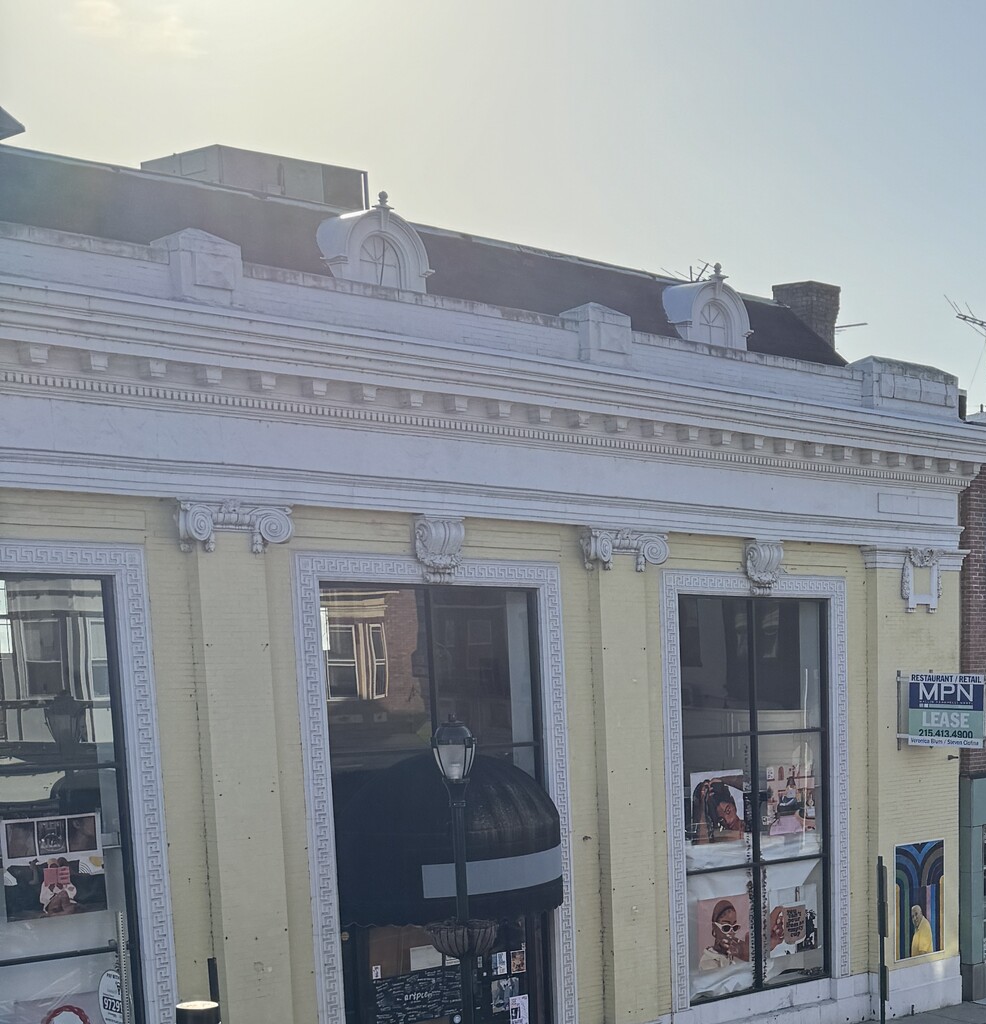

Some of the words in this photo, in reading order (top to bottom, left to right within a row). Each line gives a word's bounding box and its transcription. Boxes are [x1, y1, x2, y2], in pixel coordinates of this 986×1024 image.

[911, 674, 953, 683] RESTAURANT
[959, 676, 982, 684] RETAIL
[919, 682, 974, 701] MPN
[922, 711, 970, 728] LEASE
[918, 729, 974, 739] 215.413.4900
